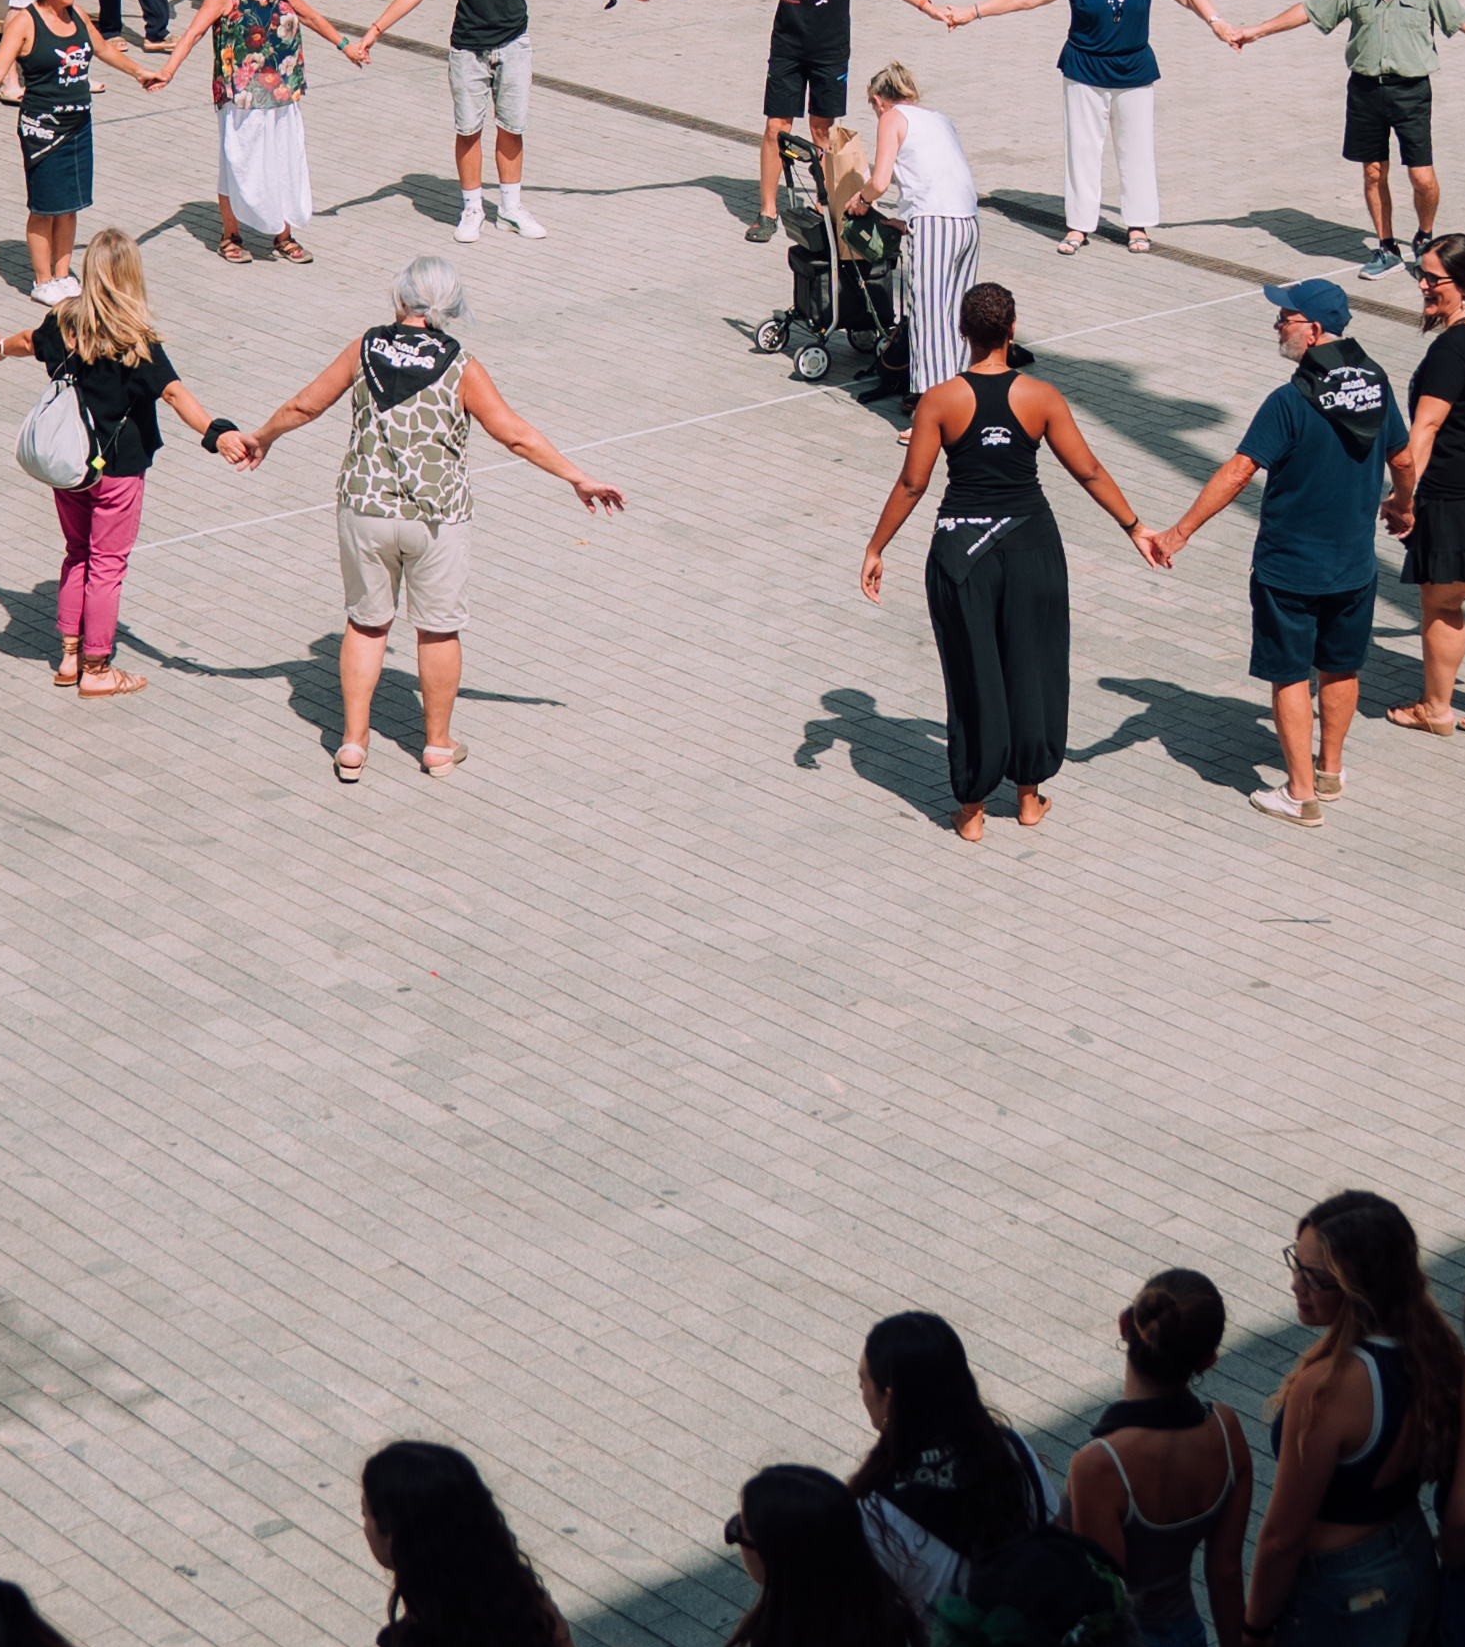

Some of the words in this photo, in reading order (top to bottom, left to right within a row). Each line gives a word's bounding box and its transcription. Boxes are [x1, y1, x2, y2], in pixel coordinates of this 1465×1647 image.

[369, 336, 436, 370] negres
[392, 339, 420, 357] mont
[1318, 383, 1382, 410] negres
